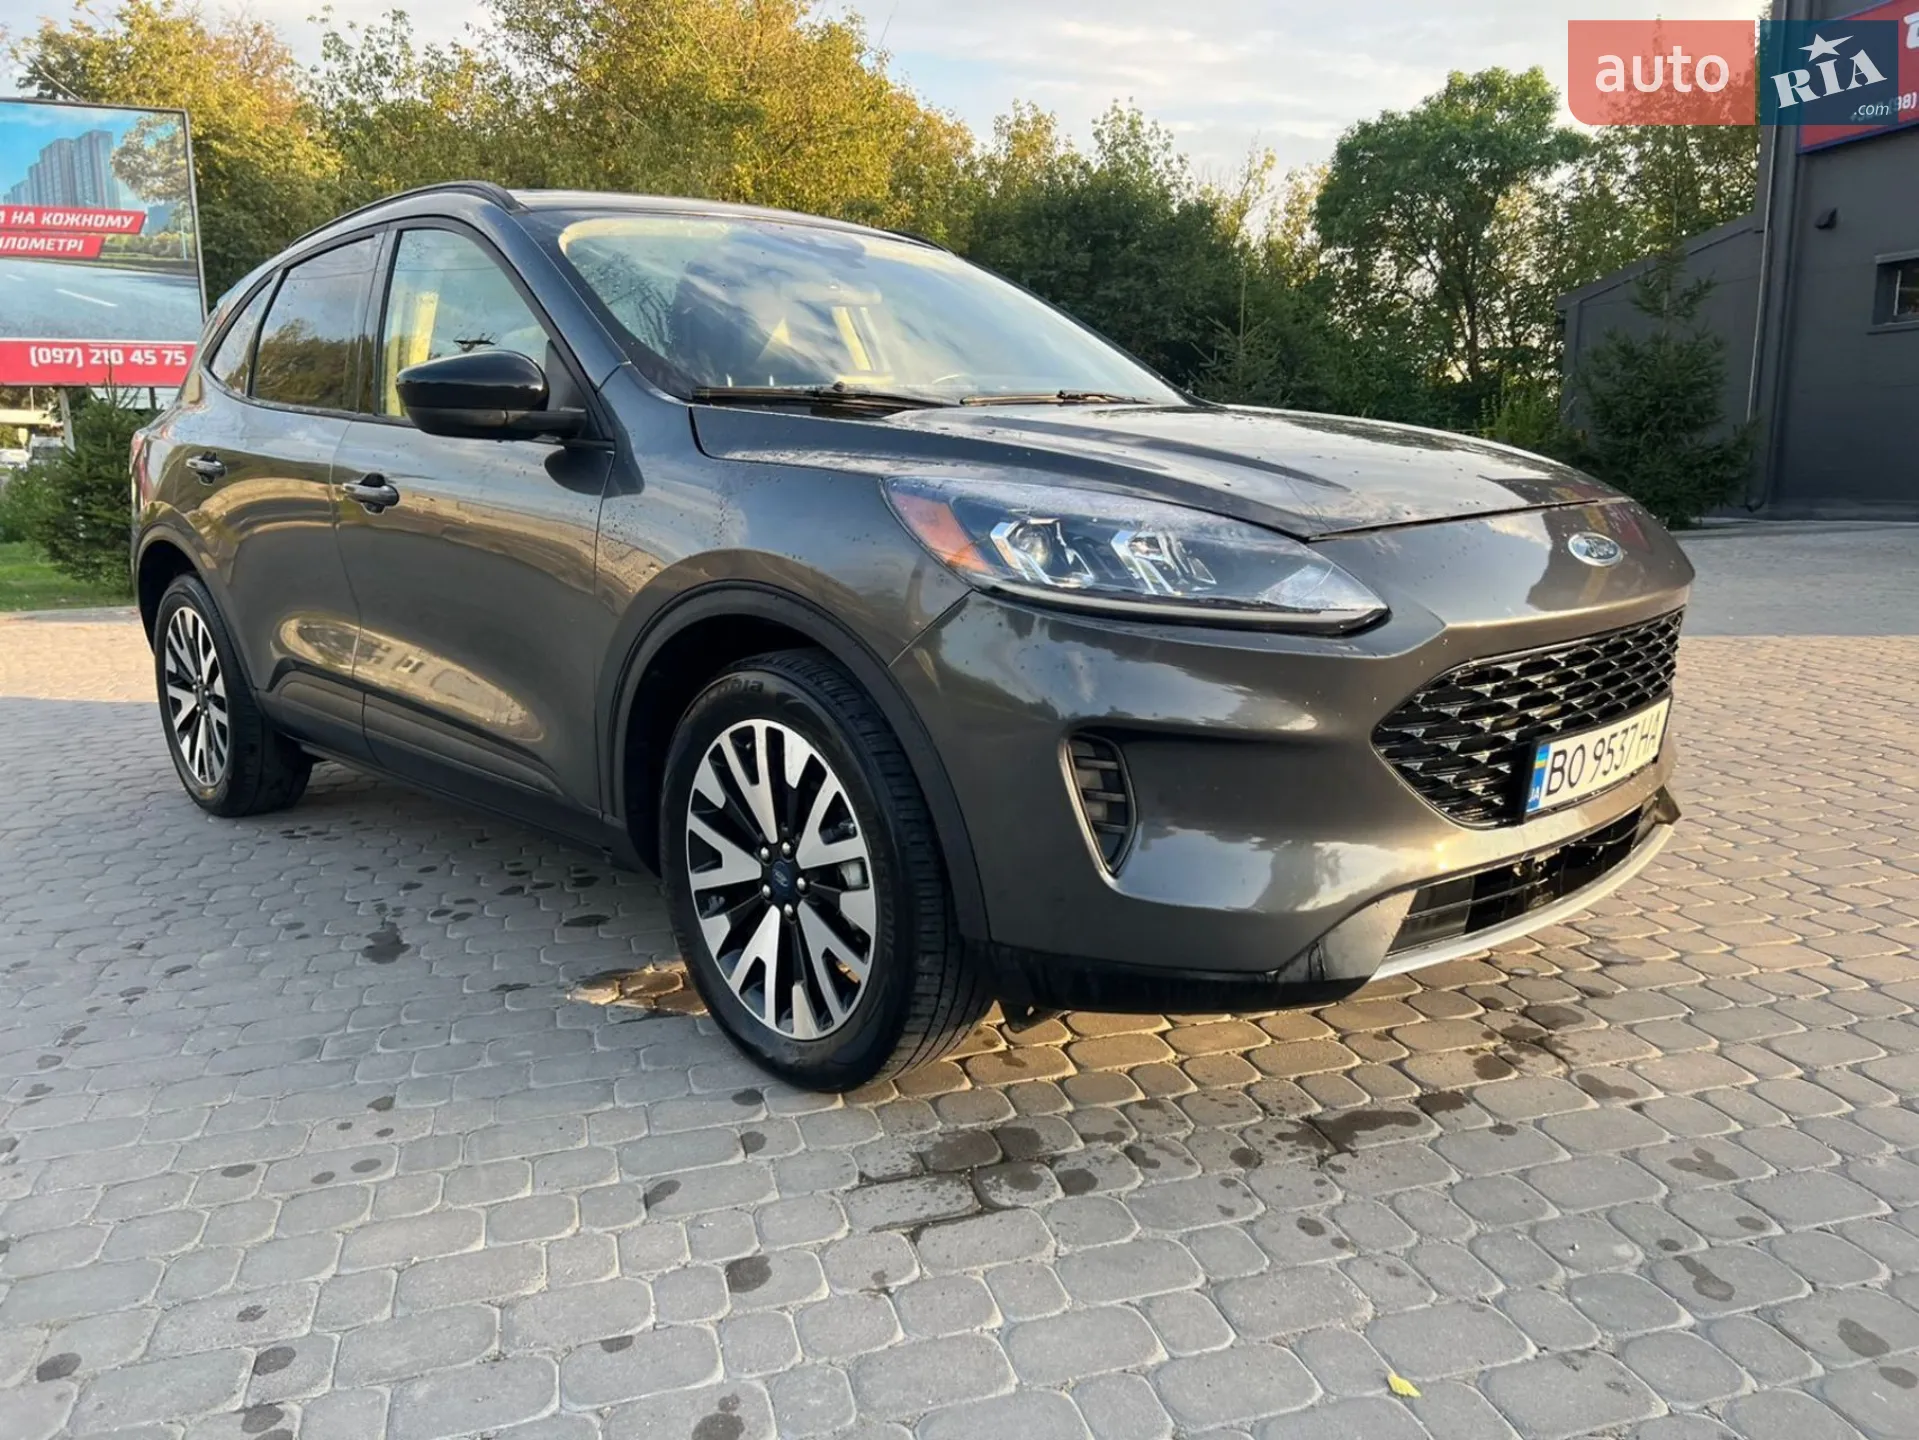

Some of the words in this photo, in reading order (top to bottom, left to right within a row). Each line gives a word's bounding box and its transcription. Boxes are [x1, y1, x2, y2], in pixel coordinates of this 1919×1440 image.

[11, 211, 35, 225] НА
[41, 212, 134, 229] КОЖНОМУ
[30, 346, 84, 368] (097)
[89, 348, 124, 365] 210
[130, 350, 157, 365] 45
[161, 350, 187, 366] 75
[1547, 744, 1586, 796] BO
[1589, 723, 1639, 783] 9537
